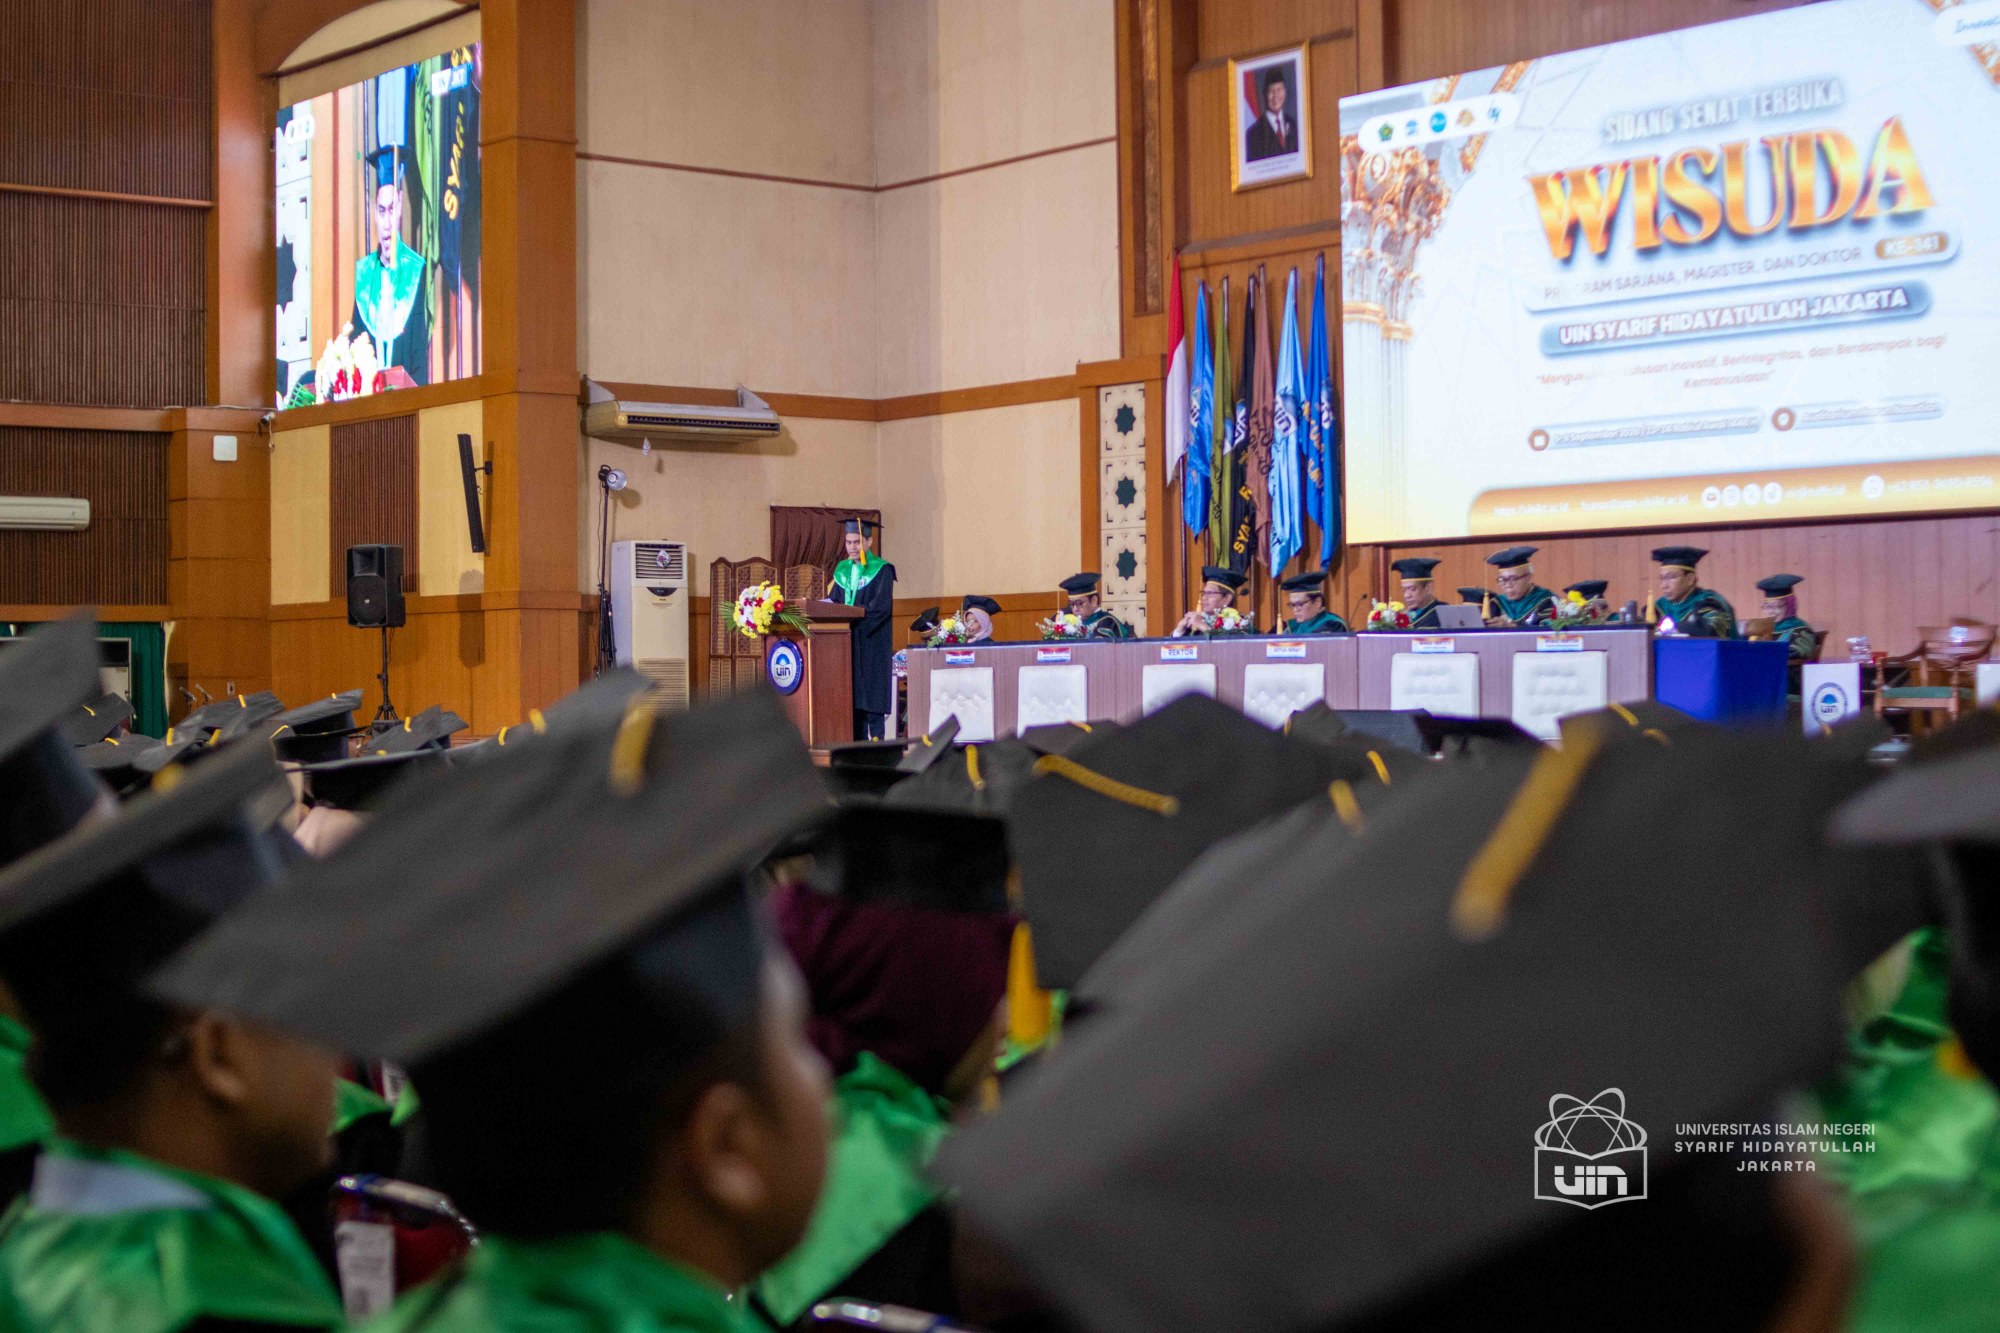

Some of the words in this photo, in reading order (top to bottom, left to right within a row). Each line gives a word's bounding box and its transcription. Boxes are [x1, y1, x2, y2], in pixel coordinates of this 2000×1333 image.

[1604, 108, 1674, 142] SIDANG
[1679, 97, 1741, 131] SENAT
[1747, 78, 1844, 120] TERBUKA
[1527, 114, 1937, 260] WISUDA
[1763, 255, 1795, 272] DAN
[1799, 247, 1862, 269] DOKTOR
[1559, 323, 1592, 346] UIN
[1592, 316, 1660, 341] SYARIF
[1659, 297, 1808, 334] HIDAYATULLAH
[1809, 286, 1909, 318] JAKARTA
[1168, 648, 1194, 656] REKTOR
